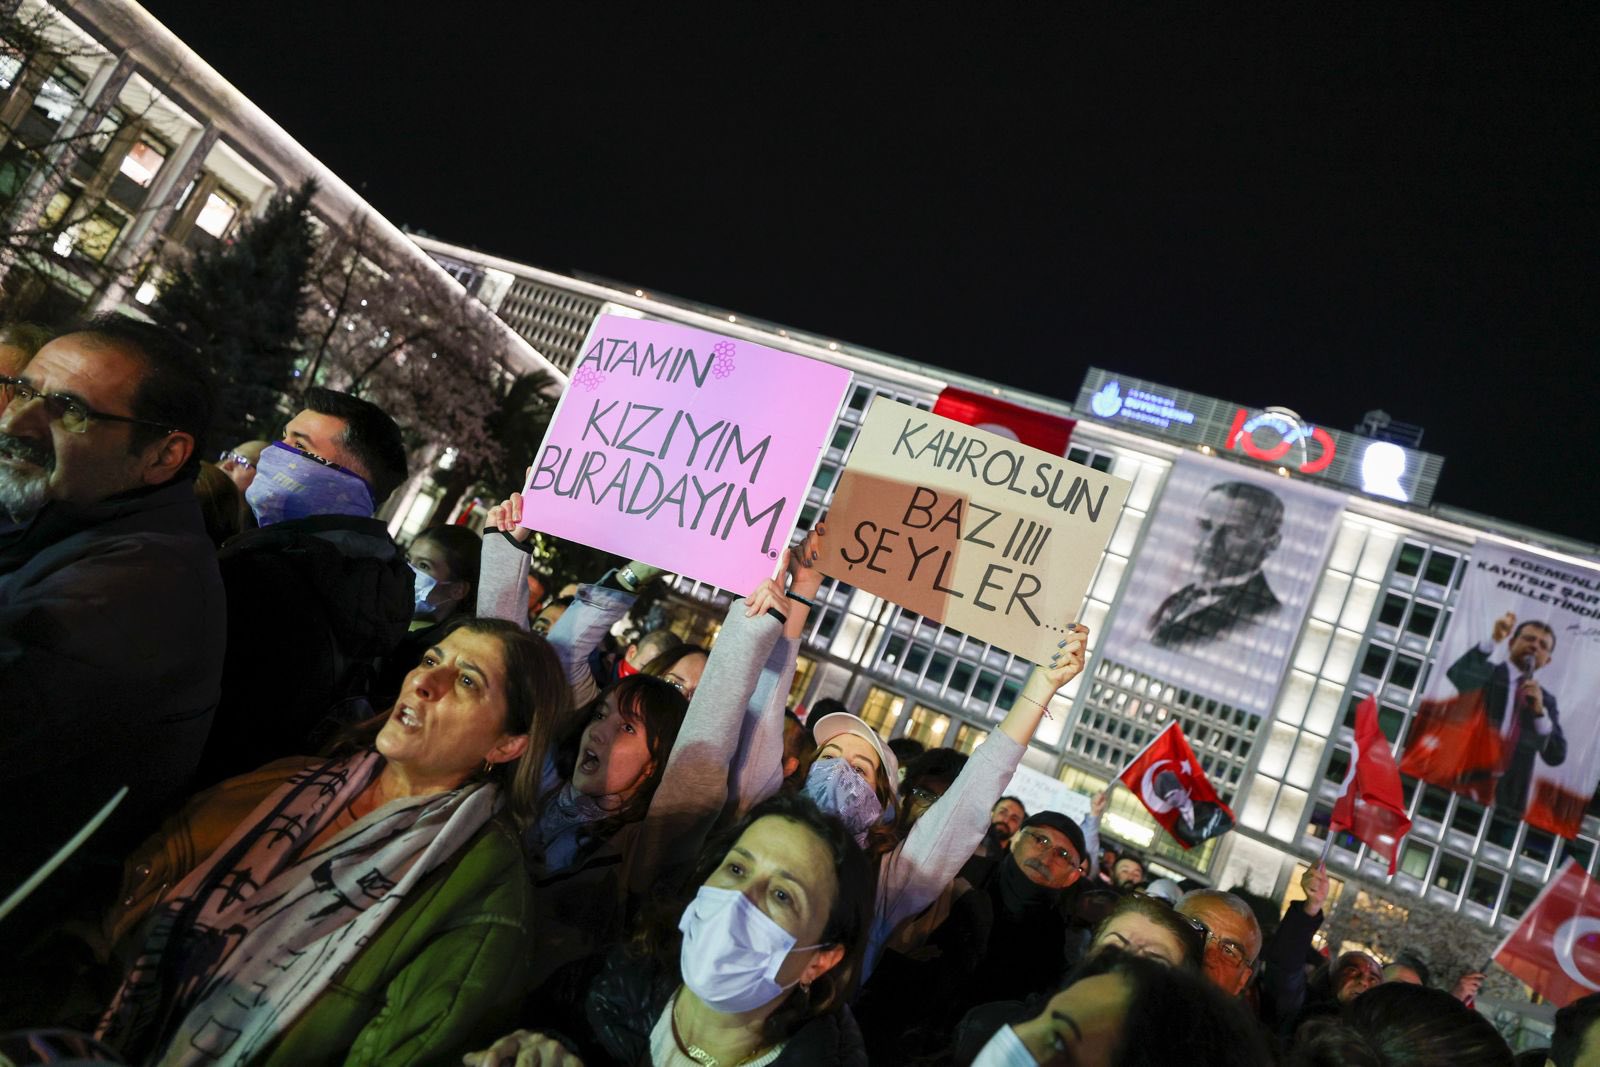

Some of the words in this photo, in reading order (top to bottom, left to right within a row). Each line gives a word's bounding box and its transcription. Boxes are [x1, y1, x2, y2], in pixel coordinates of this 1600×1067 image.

[577, 337, 716, 388] ATAMIN
[581, 398, 772, 485] KIZIYIM
[892, 418, 1109, 523] KAHROLSUN
[529, 444, 787, 559] BURADAYIM.
